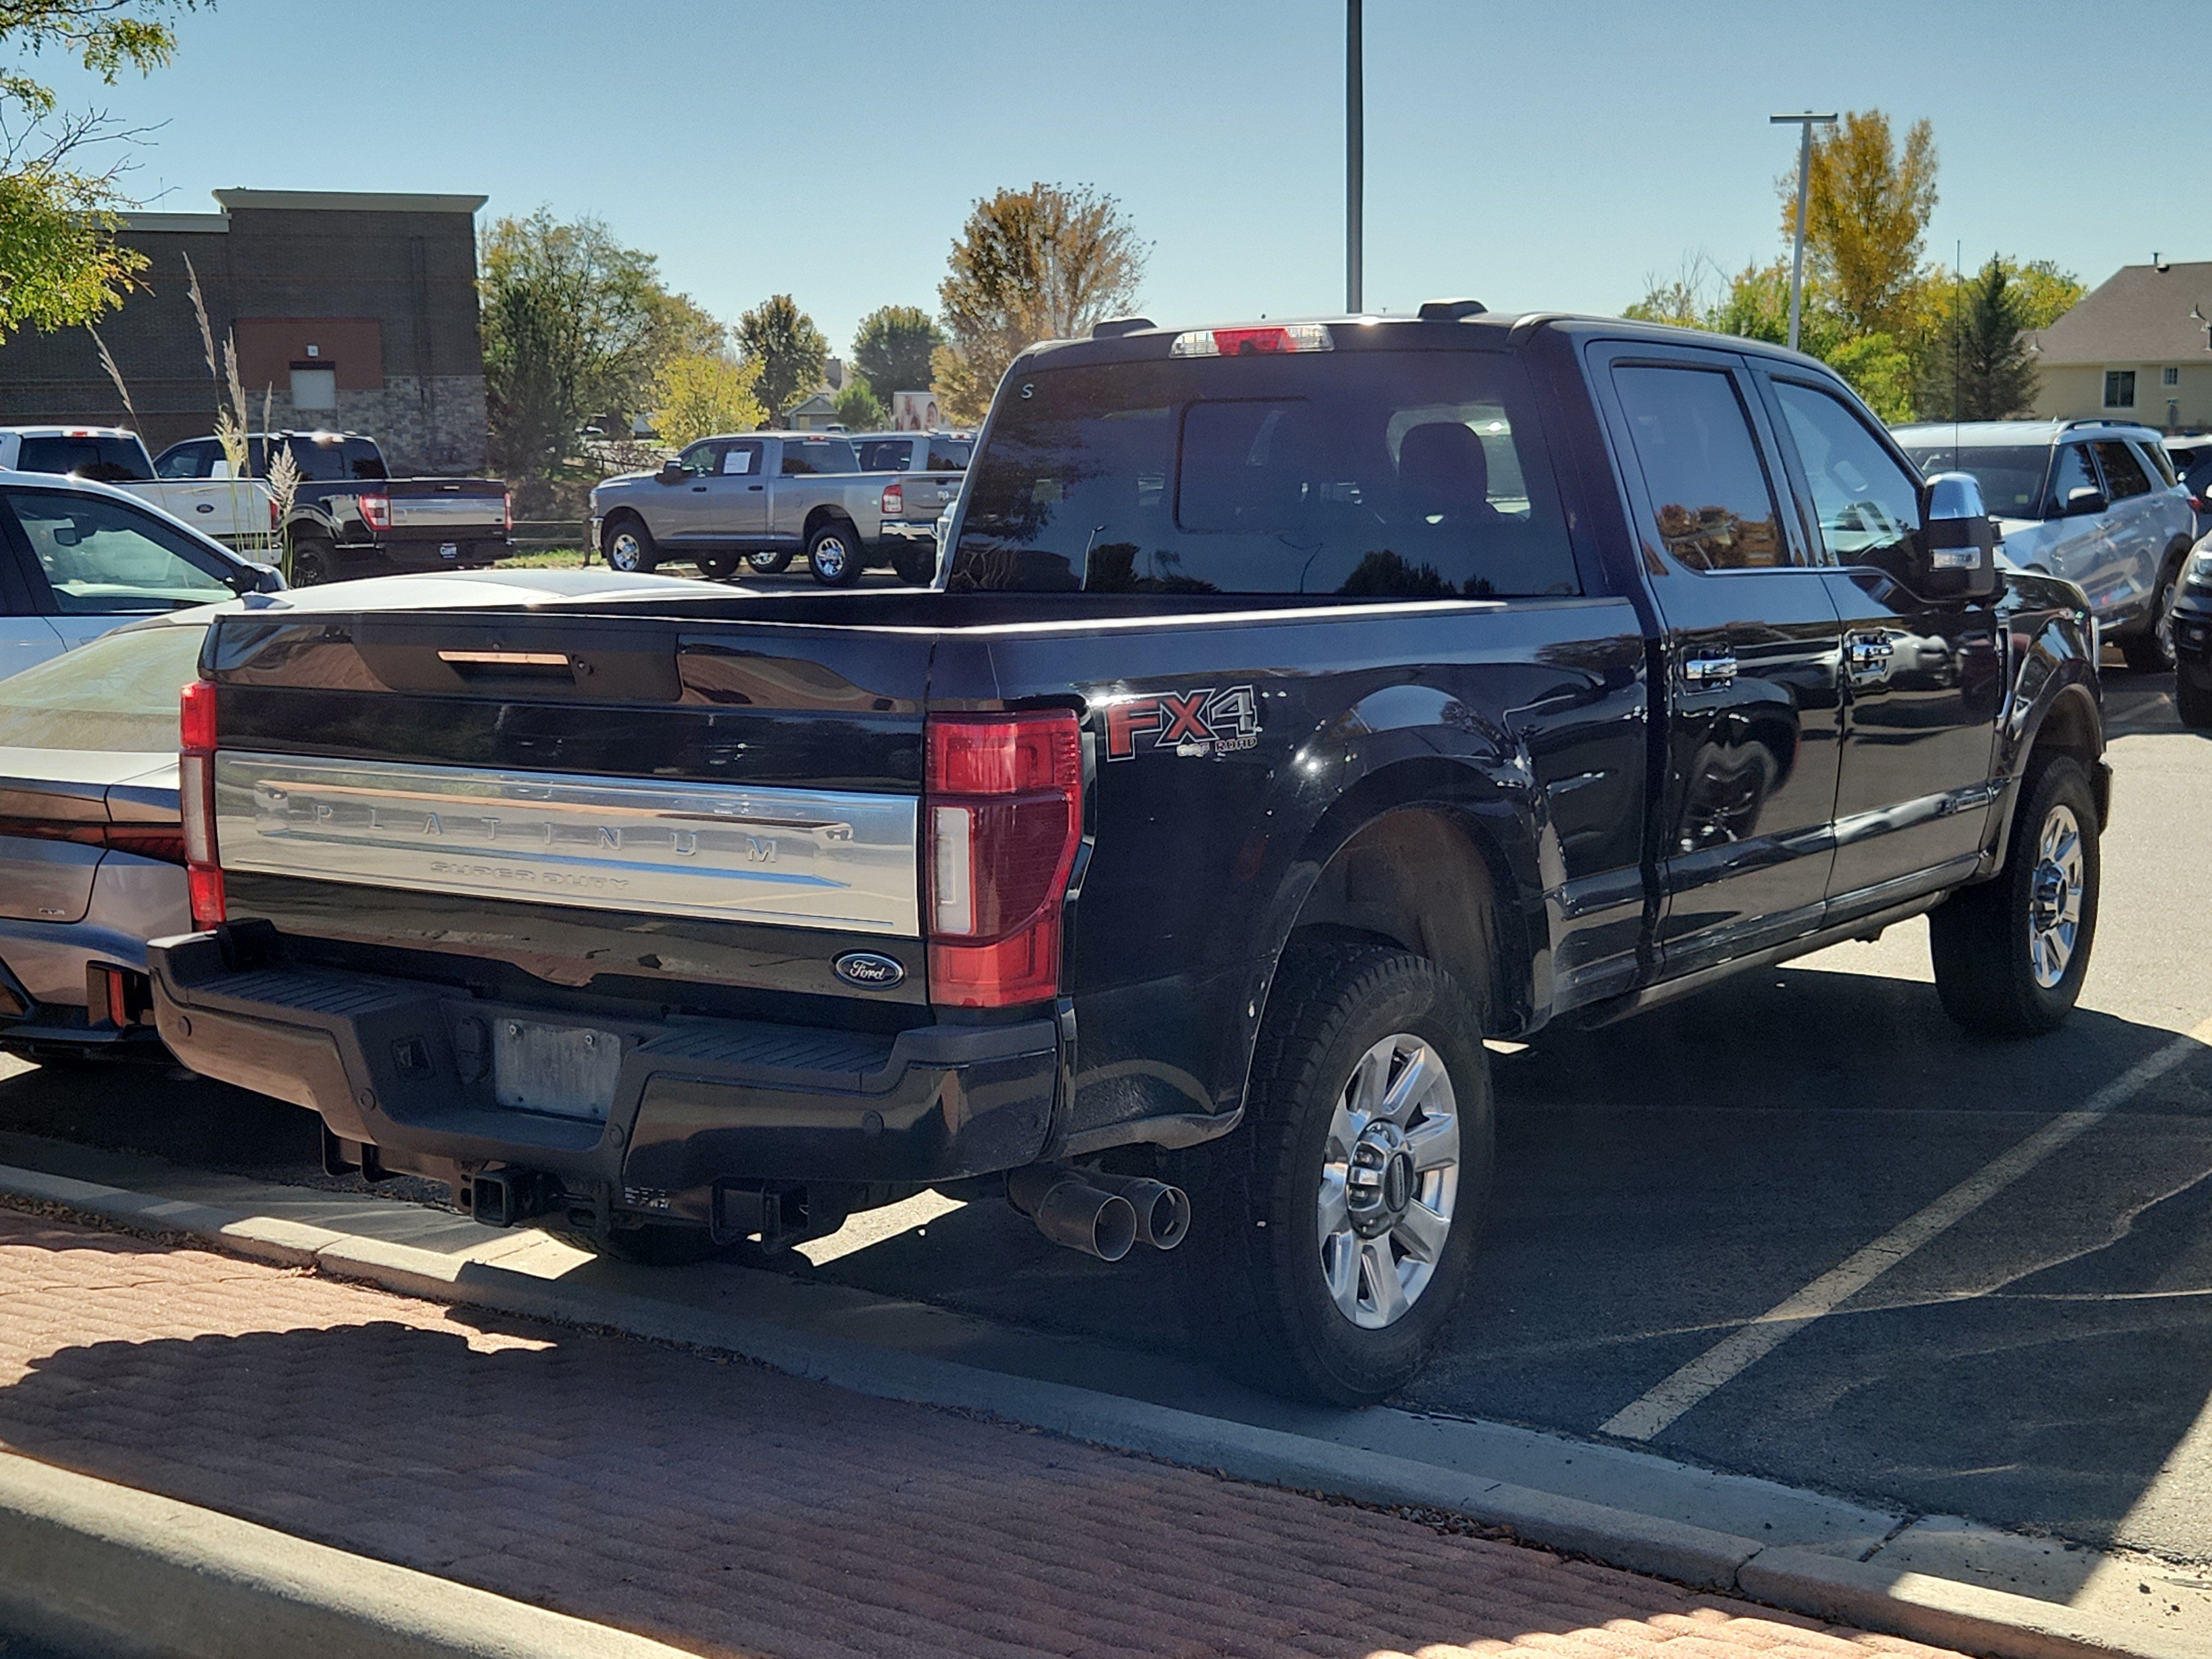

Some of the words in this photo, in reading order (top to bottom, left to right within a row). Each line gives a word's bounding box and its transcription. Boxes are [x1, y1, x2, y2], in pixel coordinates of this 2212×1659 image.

[1104, 685, 1257, 762] FX4
[1215, 737, 1257, 753] ROAD
[317, 803, 776, 863] PLATINUM
[430, 861, 535, 882] SUPER
[543, 872, 629, 890] DUTY
[850, 960, 885, 980] Ford
